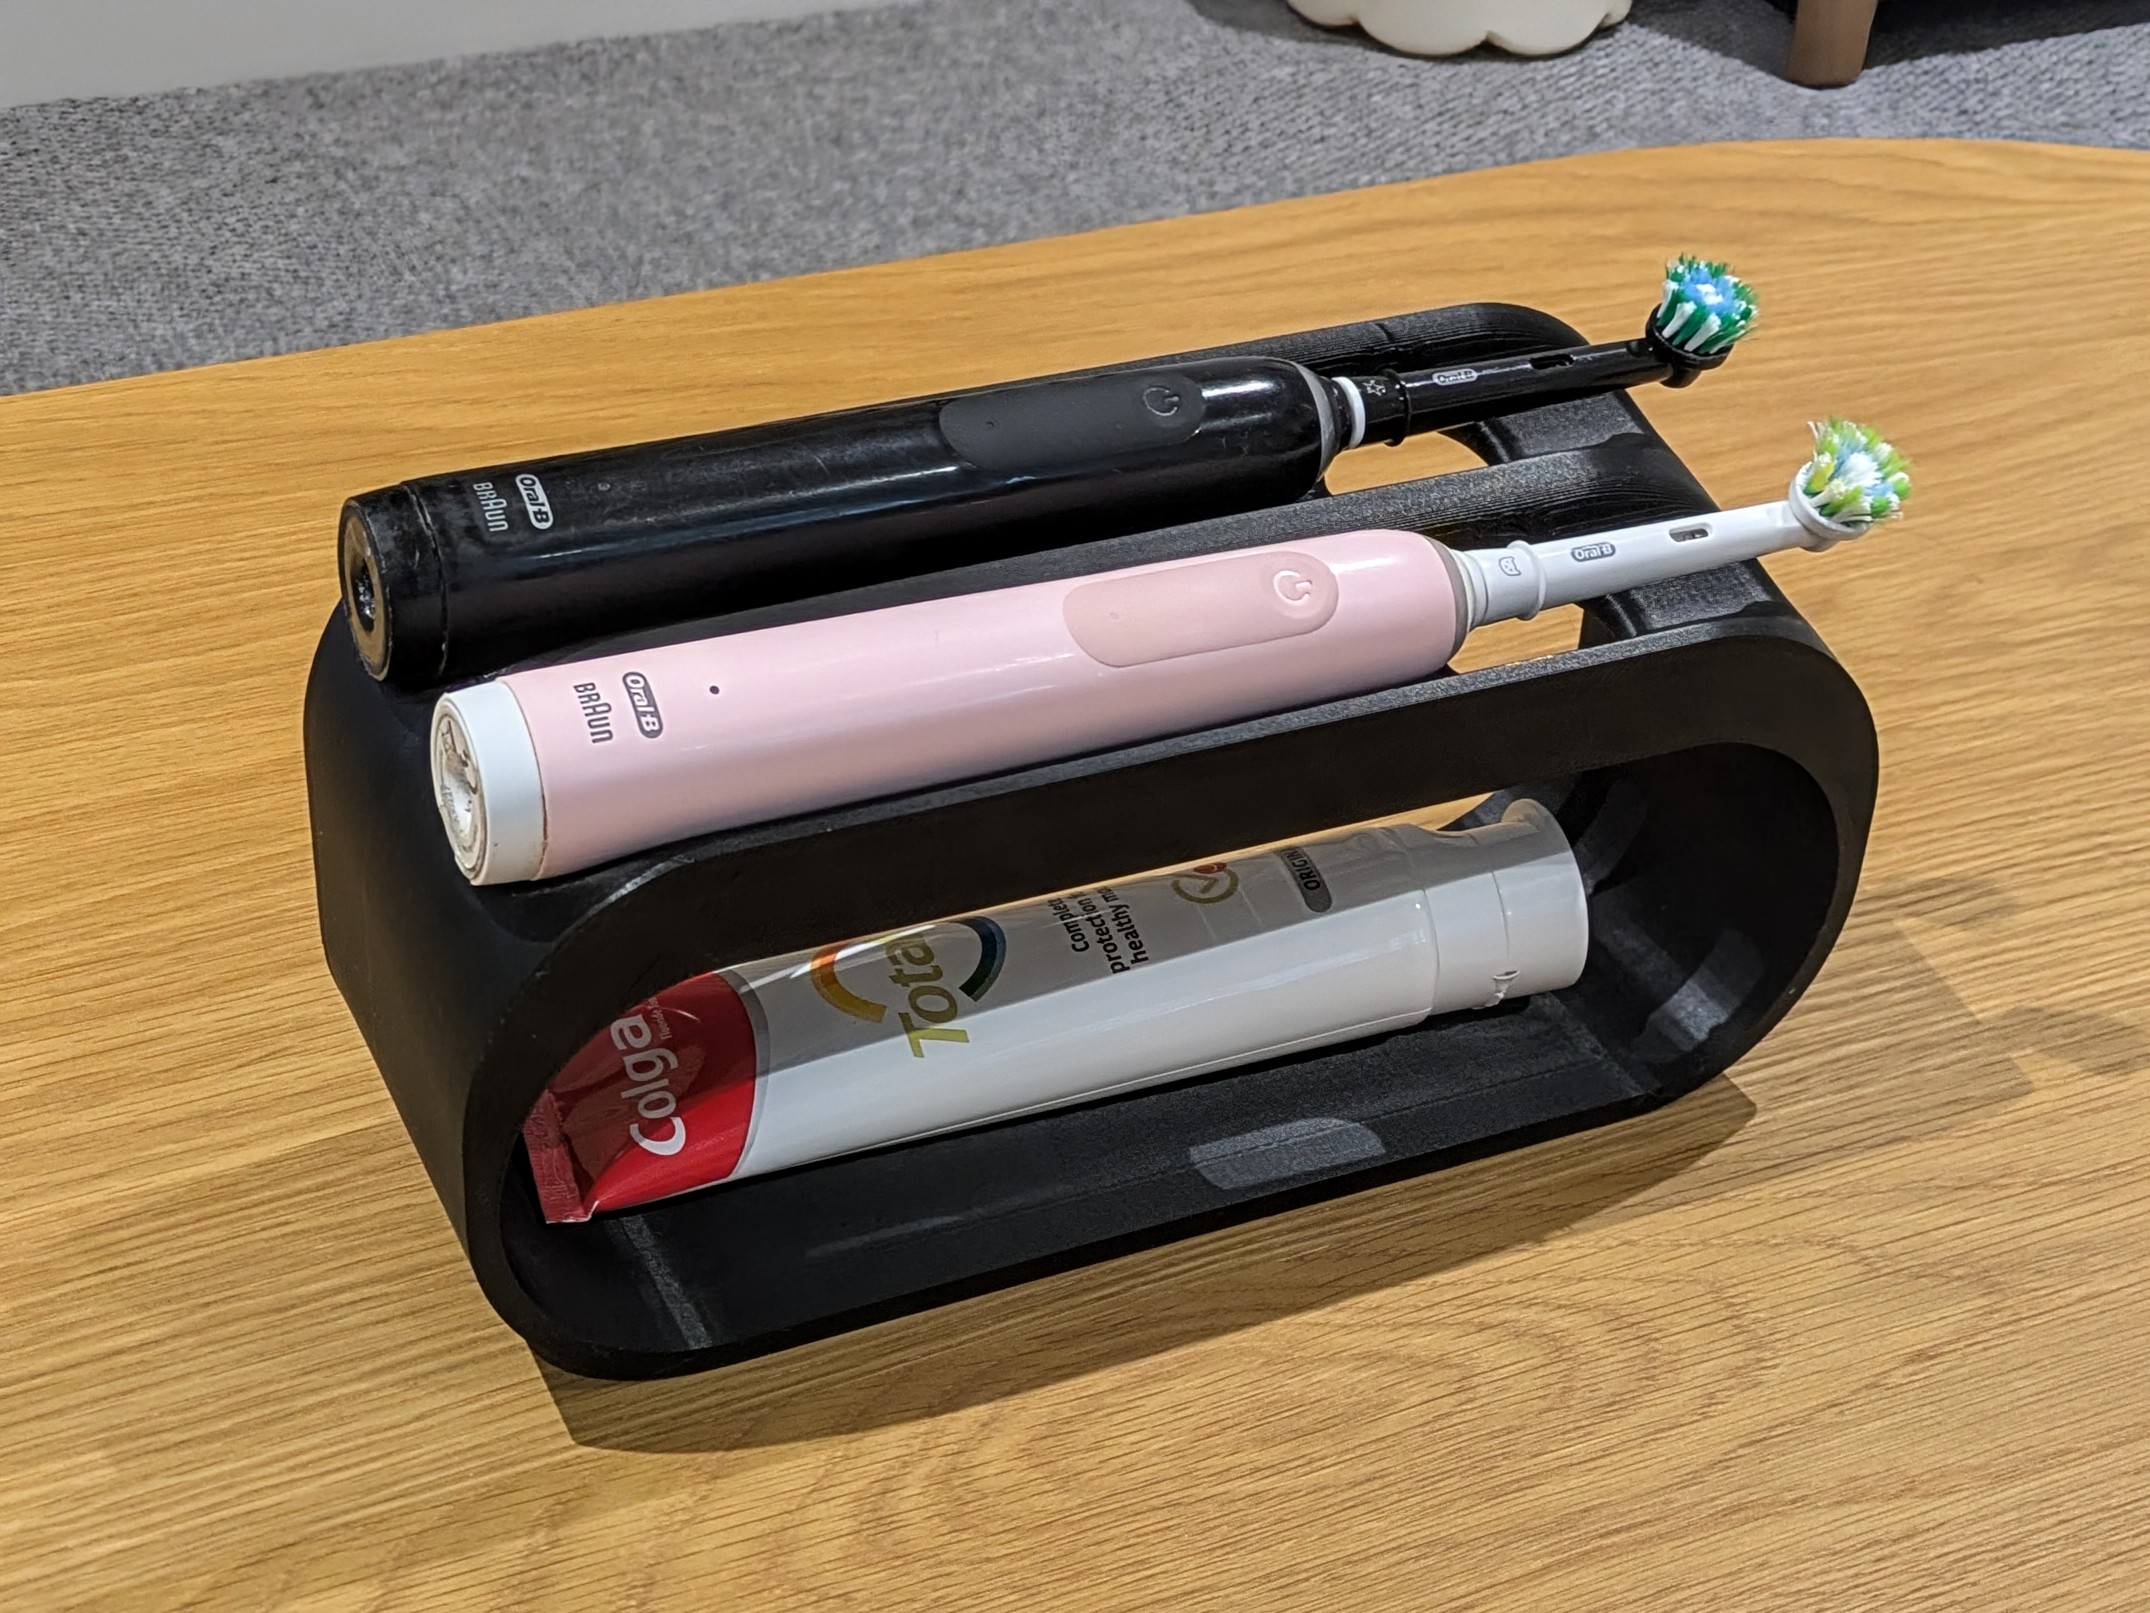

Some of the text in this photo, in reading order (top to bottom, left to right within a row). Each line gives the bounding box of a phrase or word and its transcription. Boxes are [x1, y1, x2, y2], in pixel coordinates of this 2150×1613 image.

[473, 481, 509, 532] BRAUN
[517, 475, 552, 527] Oral-B
[573, 682, 613, 744] BRAUN
[625, 674, 661, 736] Oral-B
[1284, 849, 1321, 891] ORIGIN
[1078, 897, 1131, 974] protection
[1109, 904, 1149, 965] healthy
[885, 934, 970, 1058] Tota
[610, 1014, 686, 1156] Colga
